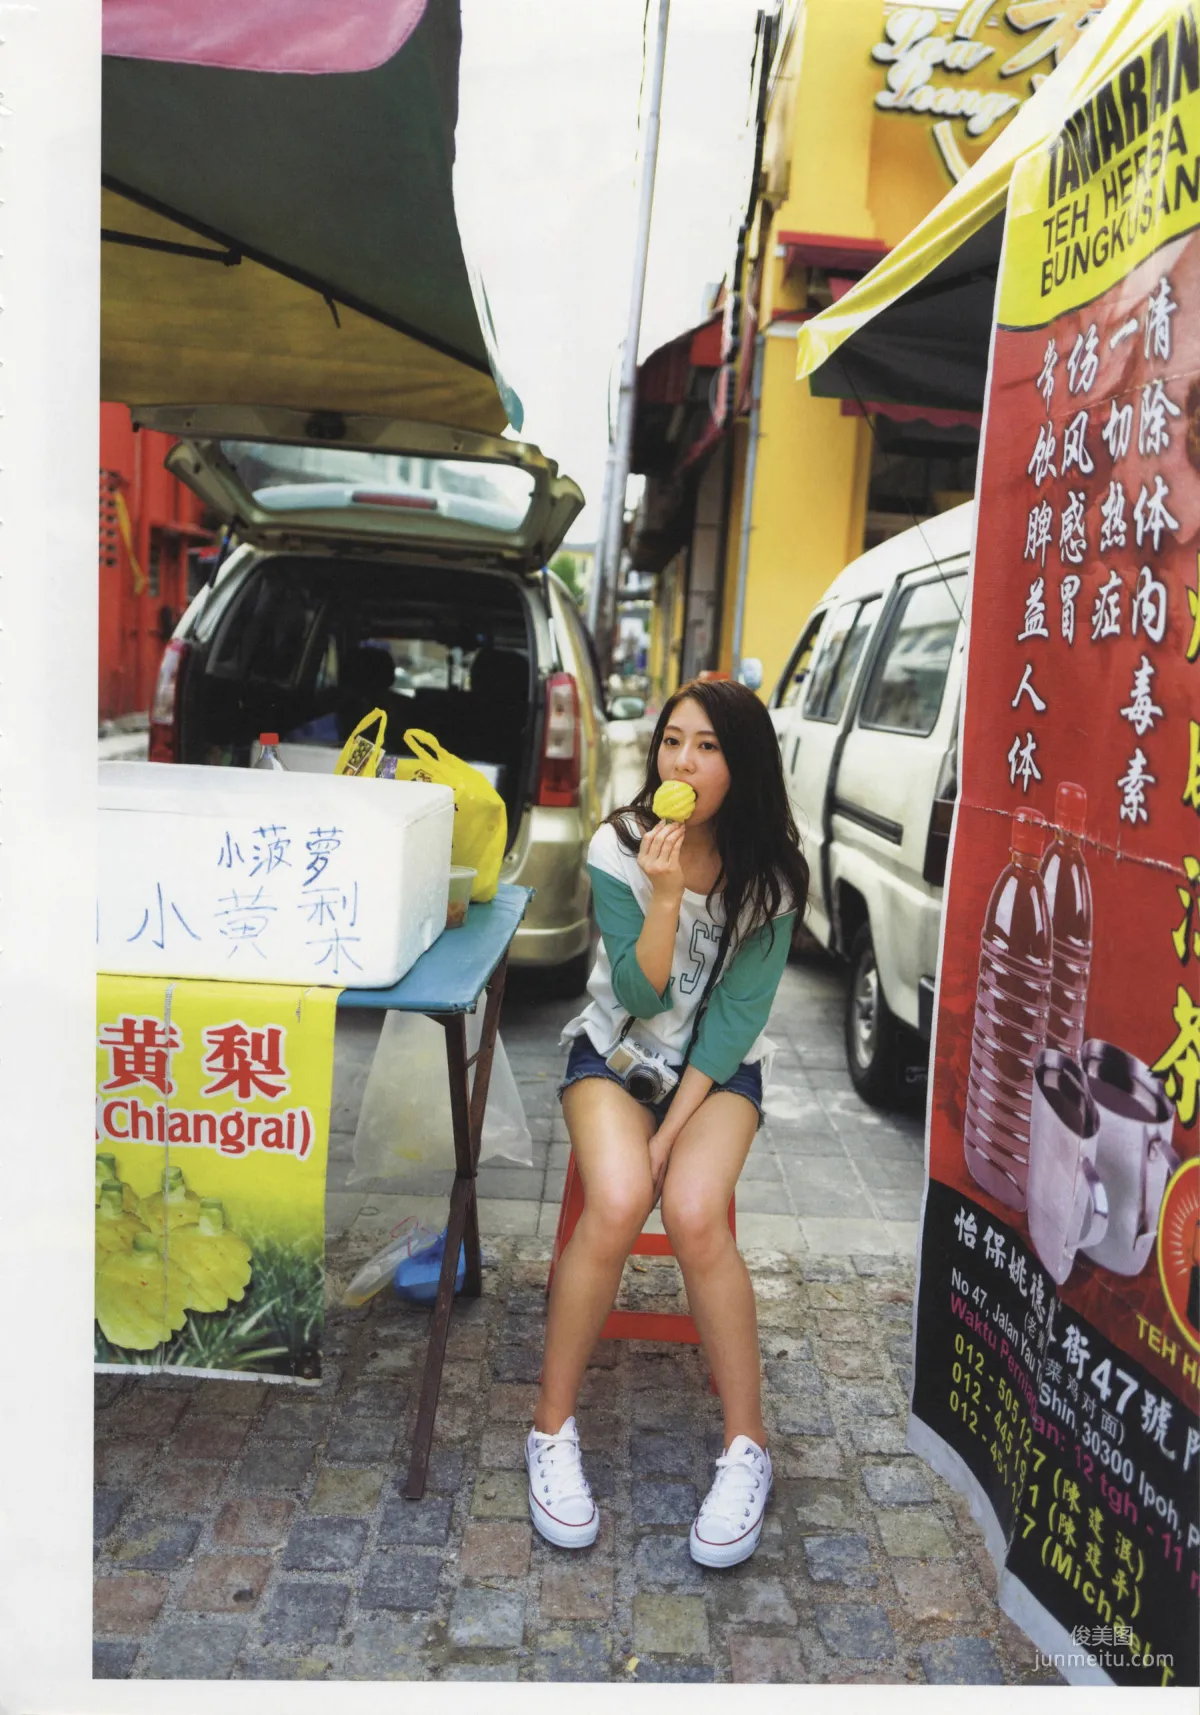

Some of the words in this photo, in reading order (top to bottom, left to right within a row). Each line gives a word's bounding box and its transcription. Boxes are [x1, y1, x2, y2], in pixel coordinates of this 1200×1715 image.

[1043, 193, 1090, 253] TEH
[1102, 115, 1188, 218] HERBA
[1048, 5, 1200, 208] TAWARAN
[1040, 156, 1200, 297] BUNGKUSAN
[1060, 324, 1099, 645] 伤风感冒
[1091, 319, 1139, 641] 一切热症
[1117, 276, 1181, 825] 清除体内毒素
[99, 1017, 287, 1100] 黄梨
[951, 1267, 969, 1295] No
[992, 1303, 1019, 1348] Jalan
[1020, 1333, 1036, 1373] Yau
[1082, 1421, 1134, 1484] 30300
[951, 1292, 997, 1351] Waktu
[1074, 1445, 1094, 1484] 12
[1100, 1472, 1138, 1527] tgh
[1161, 1532, 1183, 1573] 11
[1136, 1313, 1176, 1366] TEH
